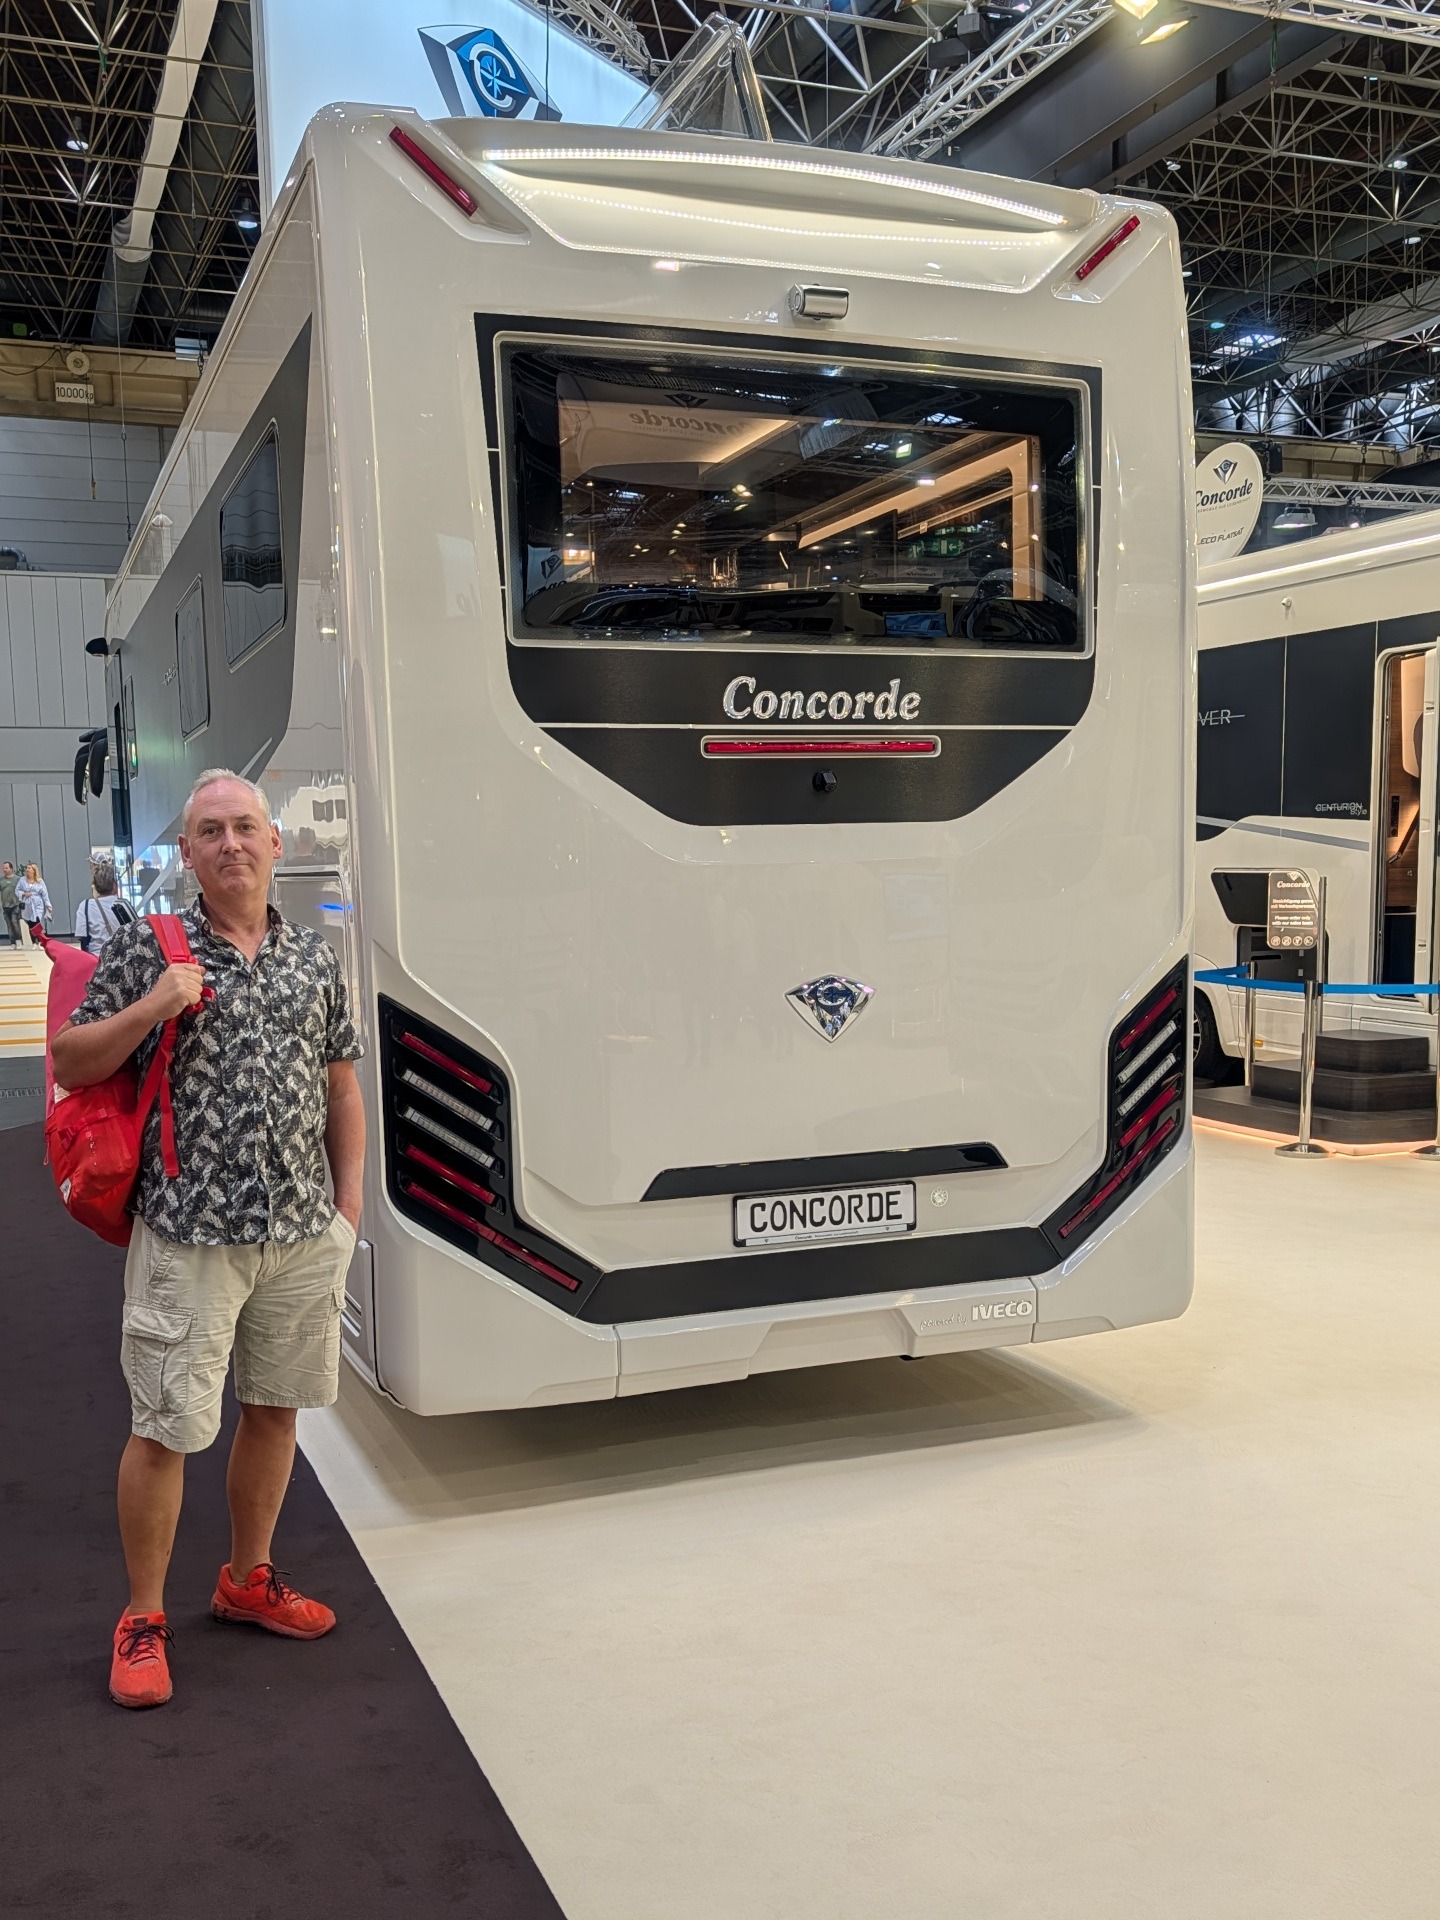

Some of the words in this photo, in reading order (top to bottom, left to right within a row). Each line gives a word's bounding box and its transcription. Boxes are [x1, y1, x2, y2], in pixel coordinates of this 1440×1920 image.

[722, 675, 922, 720] Concorde
[1315, 802, 1363, 812] CENTURION
[750, 1190, 903, 1233] CONCORDE
[971, 1300, 1033, 1321] IVECO
